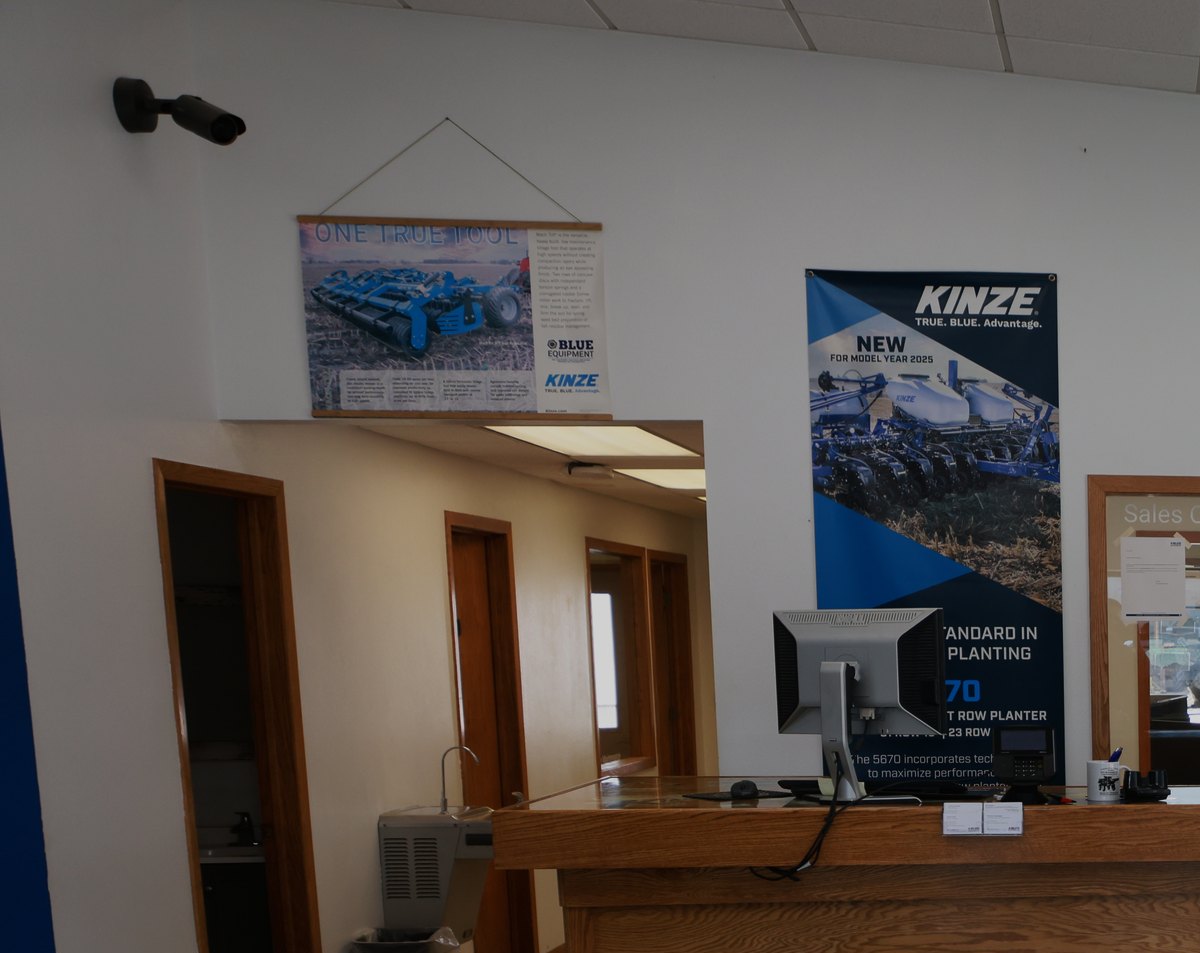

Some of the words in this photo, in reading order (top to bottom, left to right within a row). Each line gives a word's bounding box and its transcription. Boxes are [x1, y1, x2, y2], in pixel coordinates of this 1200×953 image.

[315, 223, 368, 243] ONE
[380, 224, 444, 244] TRUE
[915, 285, 1041, 316] KINZE
[915, 318, 947, 327] TRUE.
[950, 318, 981, 328] BLUE.
[984, 319, 1042, 330] Advantage.
[558, 340, 594, 350] BLUE
[857, 335, 906, 353] NEW
[547, 350, 595, 359] EQUIPMENT
[830, 354, 849, 363] FOR
[851, 354, 882, 363] MODEL
[884, 355, 908, 363] YEAR
[911, 355, 934, 364] 2025
[545, 374, 599, 387] KINZE
[1124, 503, 1183, 524] Sales
[943, 626, 1016, 640] ANDARD
[1021, 626, 1038, 640] IN
[948, 646, 1032, 660] PLANTING
[945, 679, 981, 702] 70
[958, 710, 987, 721] ROW
[990, 710, 1047, 721] PLANTER
[948, 727, 962, 737] 23
[965, 727, 991, 737] ROW
[852, 755, 870, 764] he
[873, 755, 901, 764] 5670
[904, 754, 971, 766] incorporates
[868, 770, 879, 778] to
[881, 769, 931, 778] maximize
